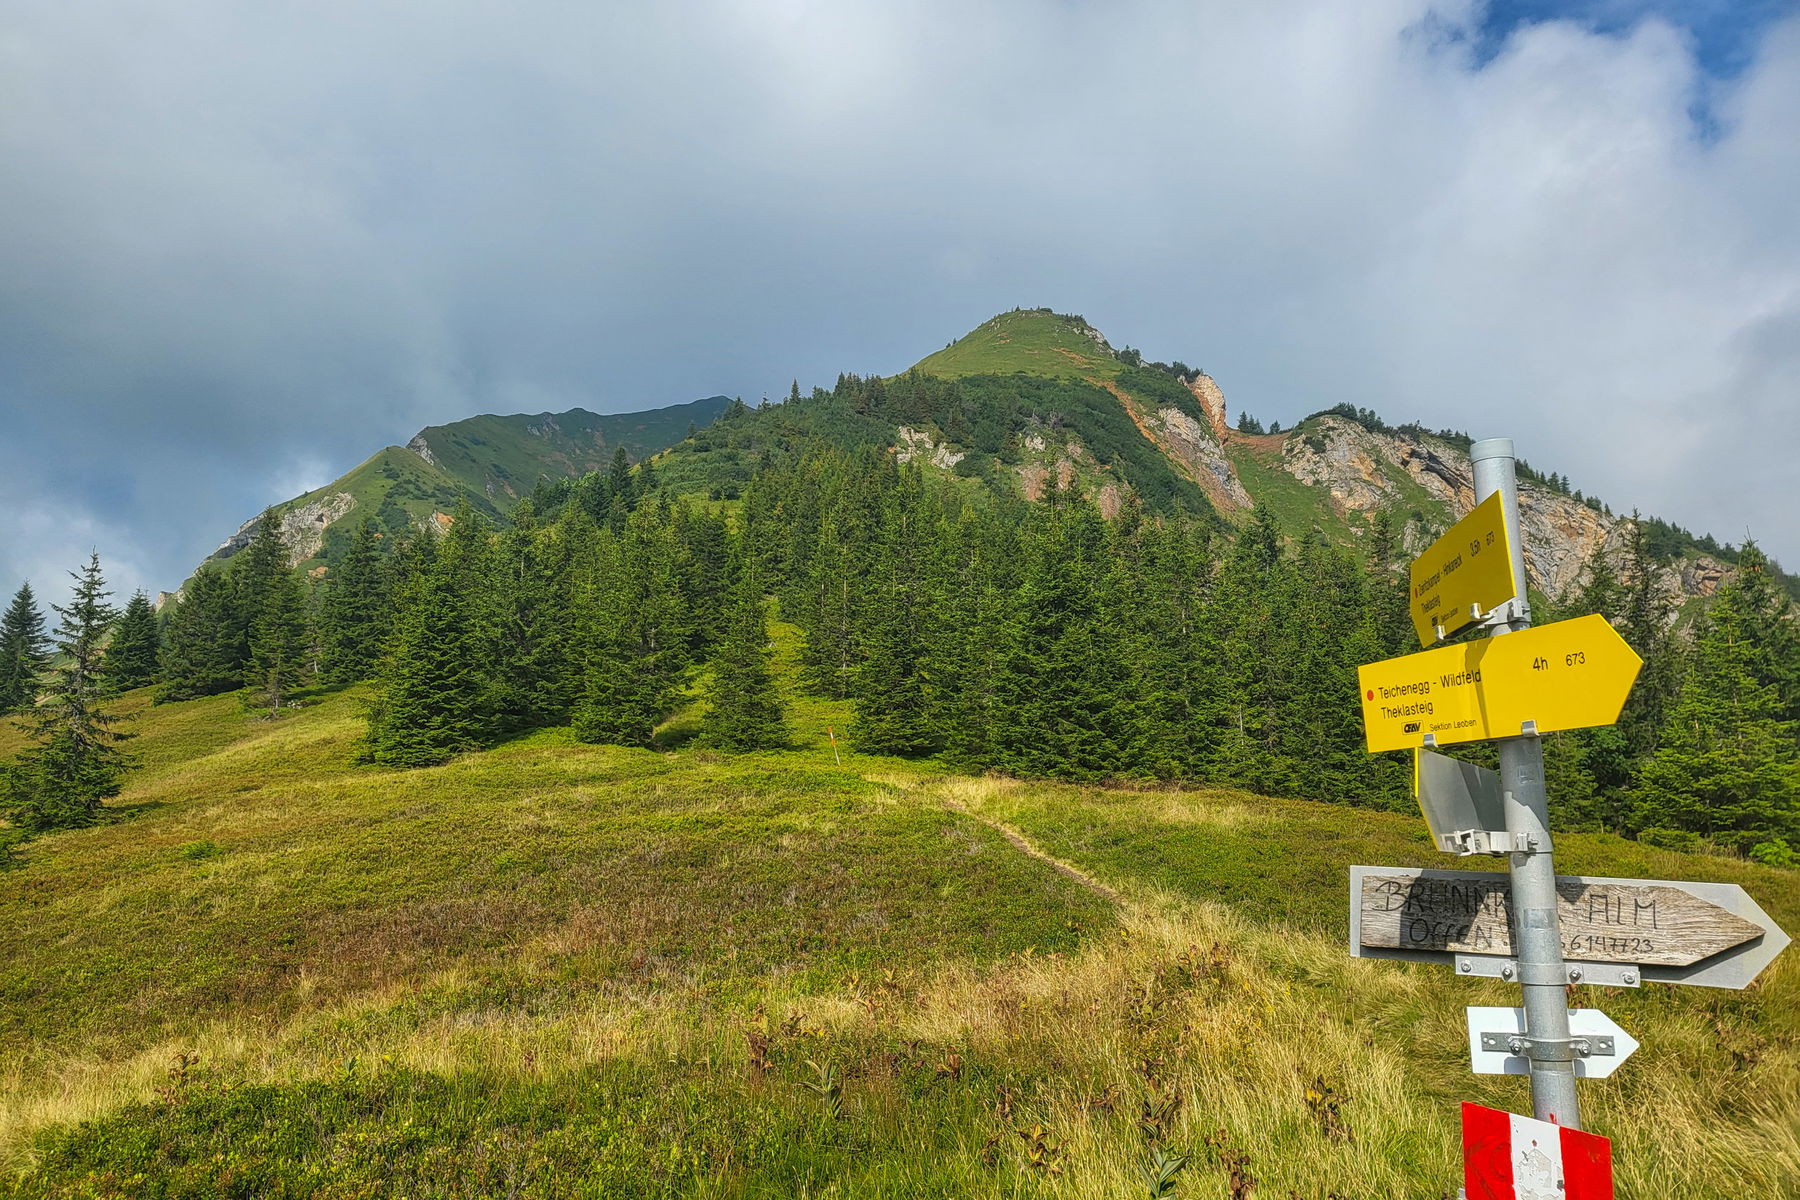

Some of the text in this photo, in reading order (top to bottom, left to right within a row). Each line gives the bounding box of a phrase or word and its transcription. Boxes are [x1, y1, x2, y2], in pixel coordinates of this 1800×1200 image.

[1378, 681, 1430, 700] Teichenegg
[1440, 669, 1482, 689] Wildfeld
[1532, 656, 1549, 672] 4h
[1565, 651, 1586, 667] 673
[1380, 701, 1434, 720] Theklasteig
[1429, 723, 1452, 732] Sektion
[1453, 719, 1477, 729] Leoben
